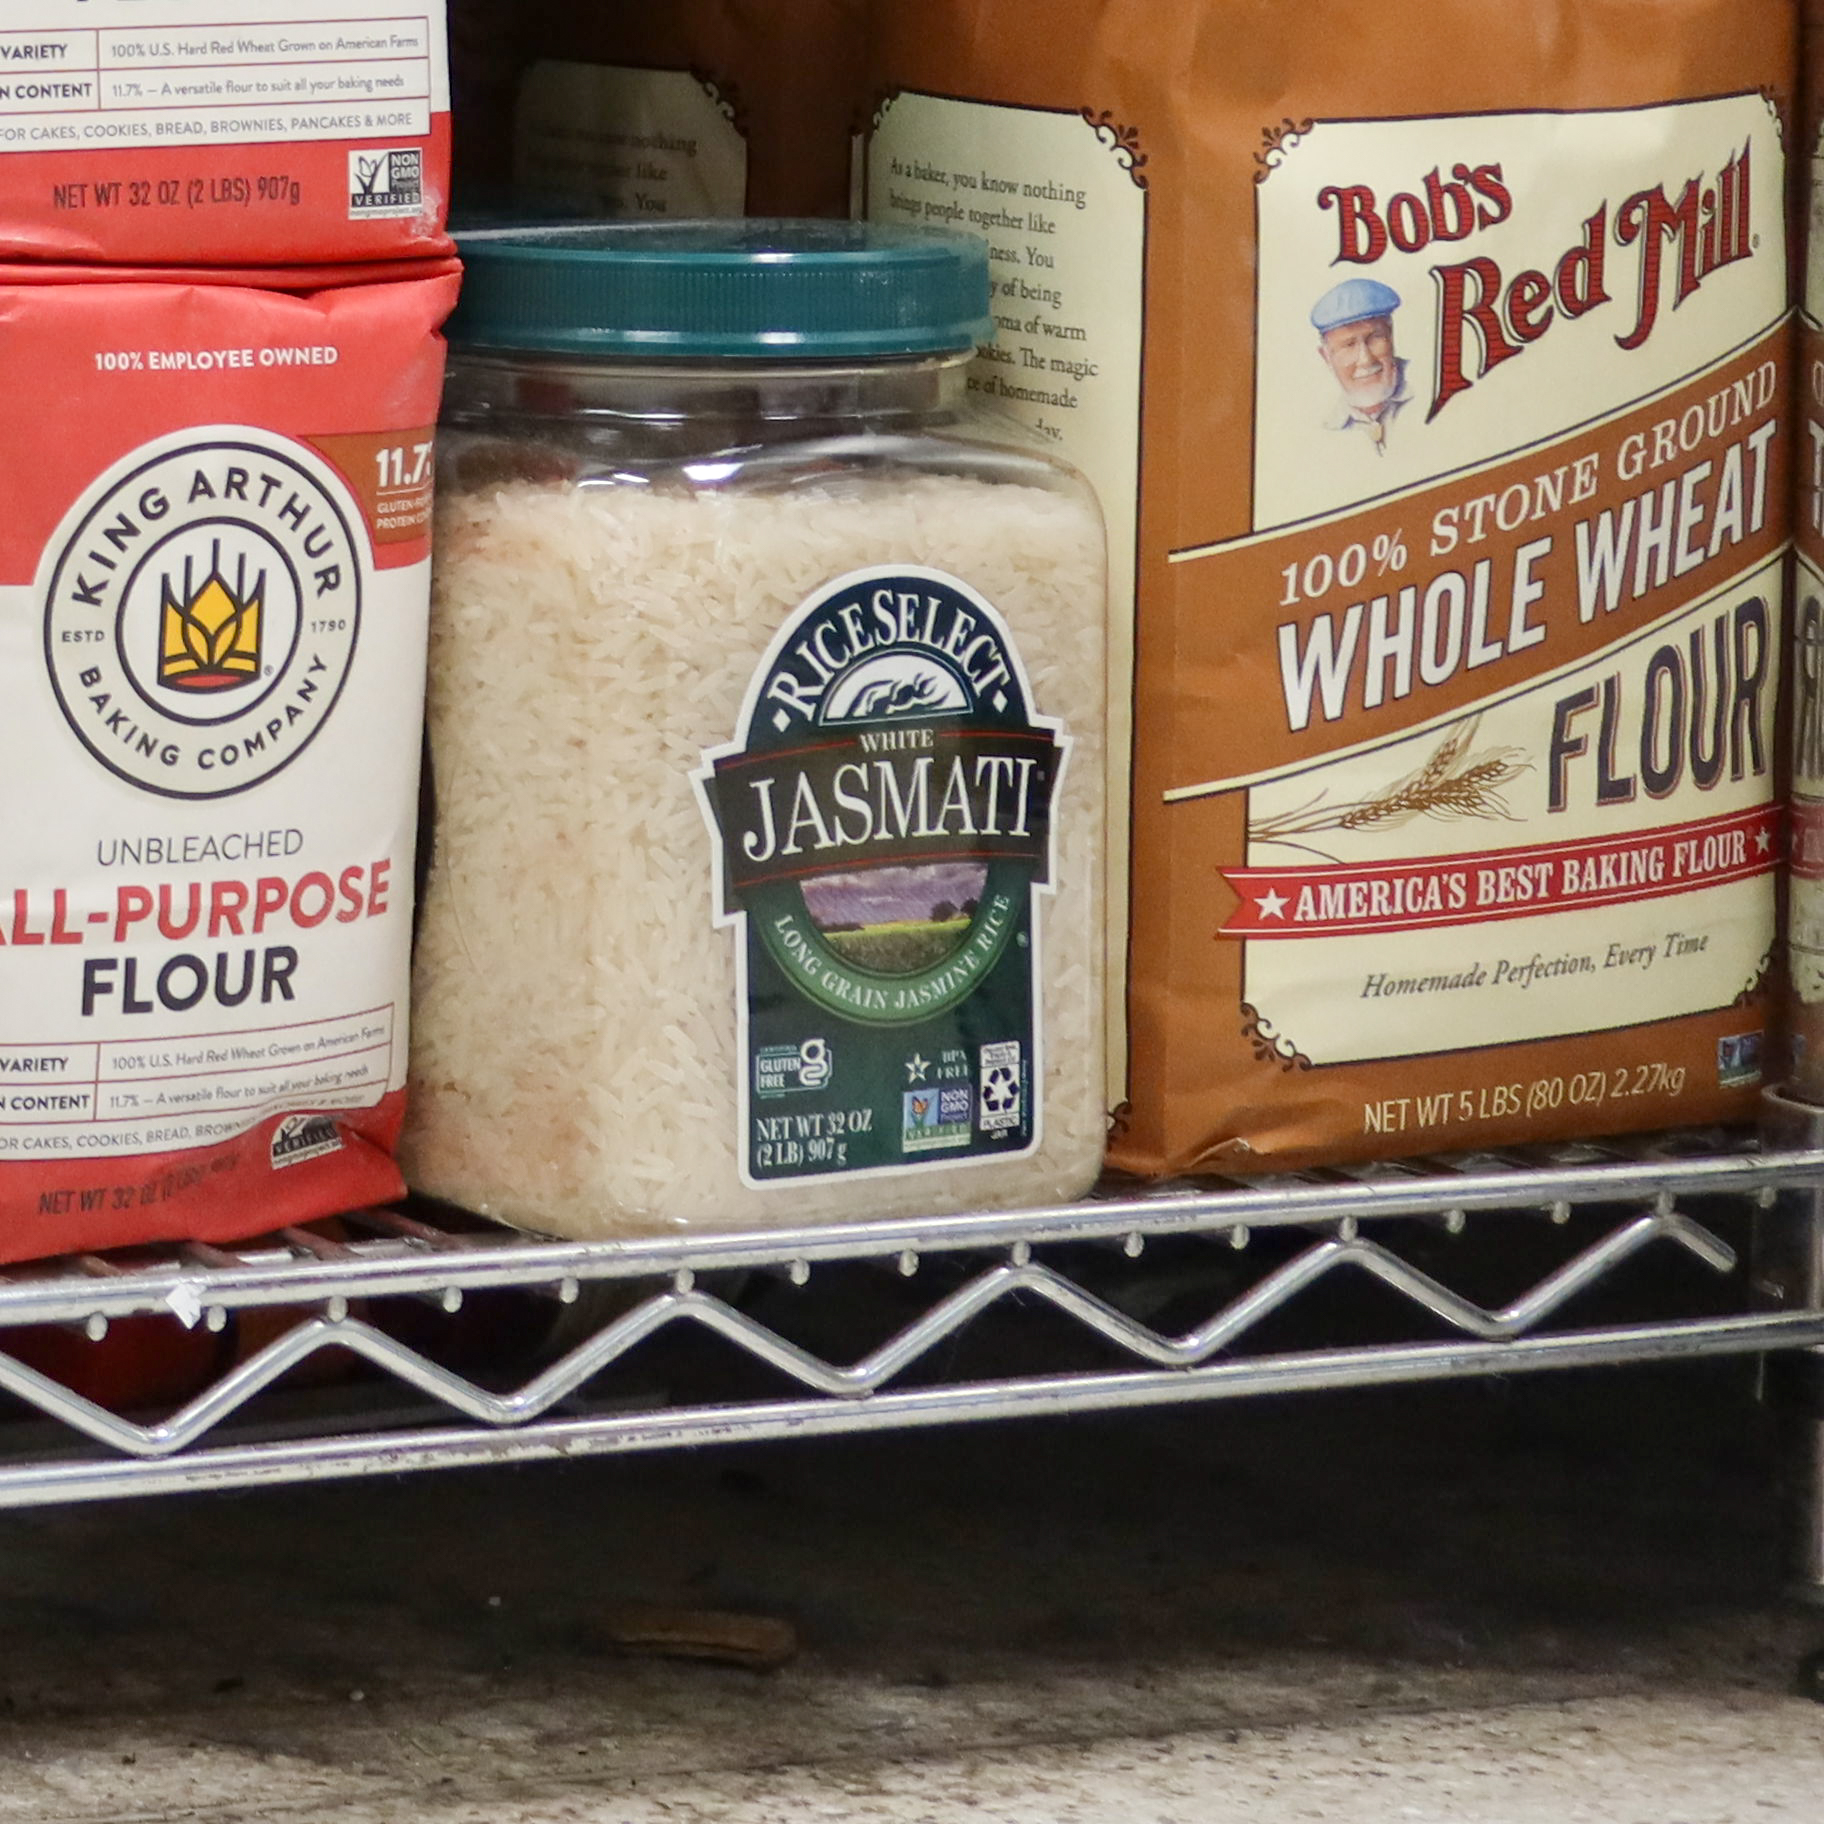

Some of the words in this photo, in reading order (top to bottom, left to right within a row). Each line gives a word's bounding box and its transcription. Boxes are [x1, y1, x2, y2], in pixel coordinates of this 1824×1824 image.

[0, 42, 68, 61] VARIETY
[14, 81, 92, 100] CONTENT
[1317, 159, 1516, 267] Bob's
[1425, 196, 1613, 424] Red
[1614, 133, 1754, 351] Mill
[1277, 531, 1409, 607] 100%
[1429, 451, 1601, 559] STONE
[1615, 360, 1778, 483] GROUND
[1277, 535, 1553, 733] WHOLE
[1575, 419, 1778, 624] WHEAT
[765, 588, 1014, 722] RICESELECT
[1548, 595, 1772, 814] FLOUR
[859, 729, 935, 753] WHITE
[744, 755, 1038, 863] JASMATI
[1295, 874, 1466, 923] AMERICA'S
[1476, 862, 1554, 907] BEST
[1560, 845, 1666, 895] BAKING
[1671, 827, 1746, 883] FLOUR
[773, 912, 821, 974] LONG
[821, 971, 890, 1012] GRAIN
[894, 948, 983, 1010] JASMINE
[976, 892, 1012, 956] RICE
[1361, 969, 1488, 999] Homemade
[1492, 950, 1597, 987] Perfection,
[1603, 940, 1658, 973] Every
[1663, 929, 1709, 958] Time
